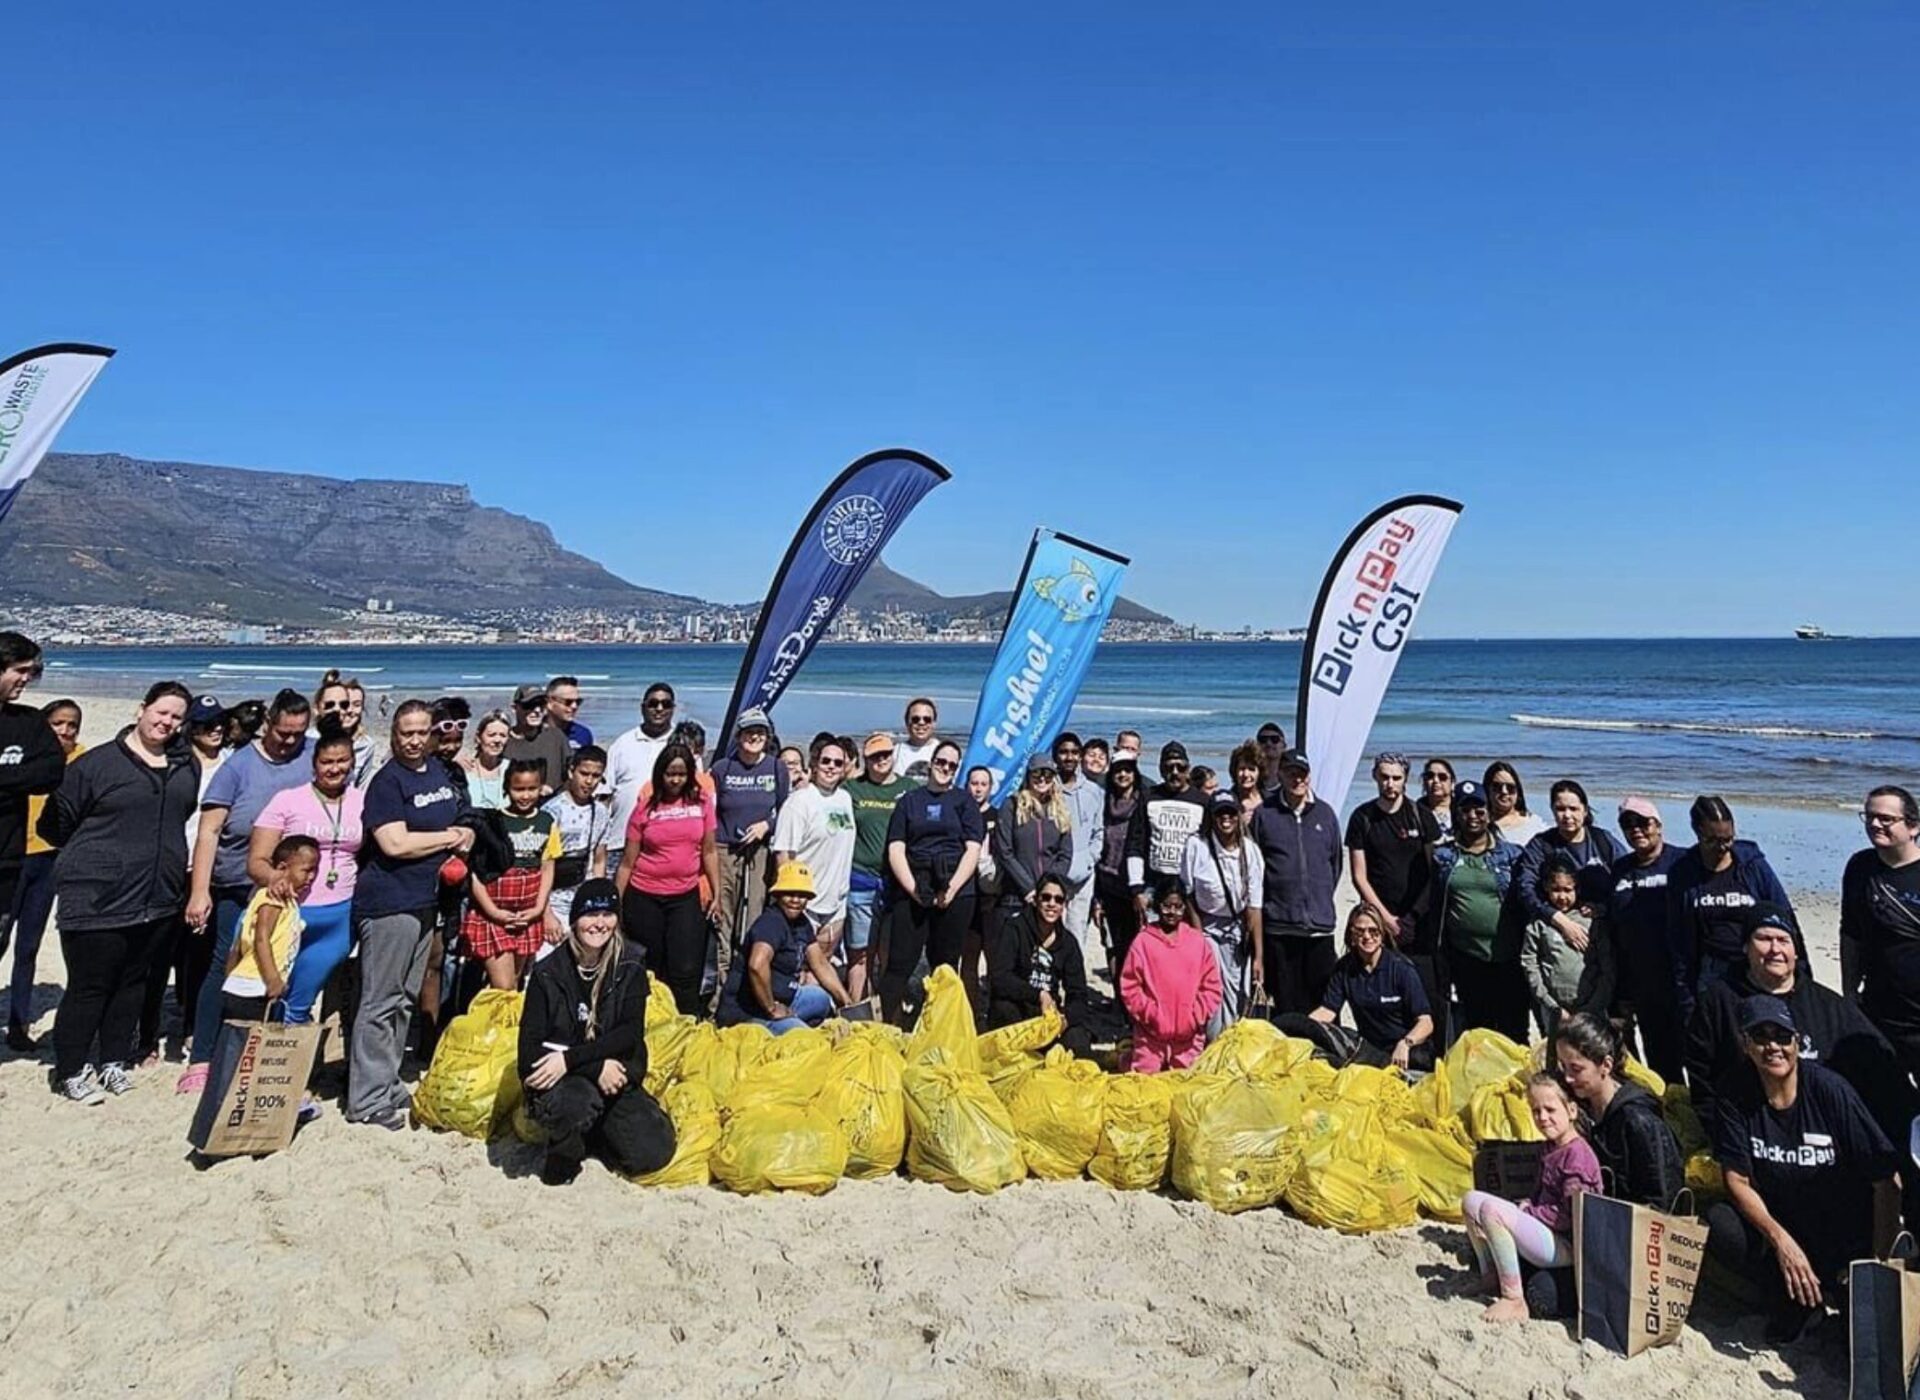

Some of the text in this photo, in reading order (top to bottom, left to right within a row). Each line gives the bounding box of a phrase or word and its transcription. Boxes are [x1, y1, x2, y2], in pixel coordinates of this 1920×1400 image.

[3, 364, 40, 409] WASTE
[1371, 581, 1421, 653] CSI
[264, 1039, 299, 1049] REDUCE
[260, 1057, 288, 1067] REUSE
[257, 1076, 293, 1086] RECYCLE
[253, 1094, 287, 1109] 100%
[1670, 1232, 1705, 1252] REDUC
[1666, 1253, 1699, 1273] REUSE
[1665, 1275, 1695, 1293] RECYC
